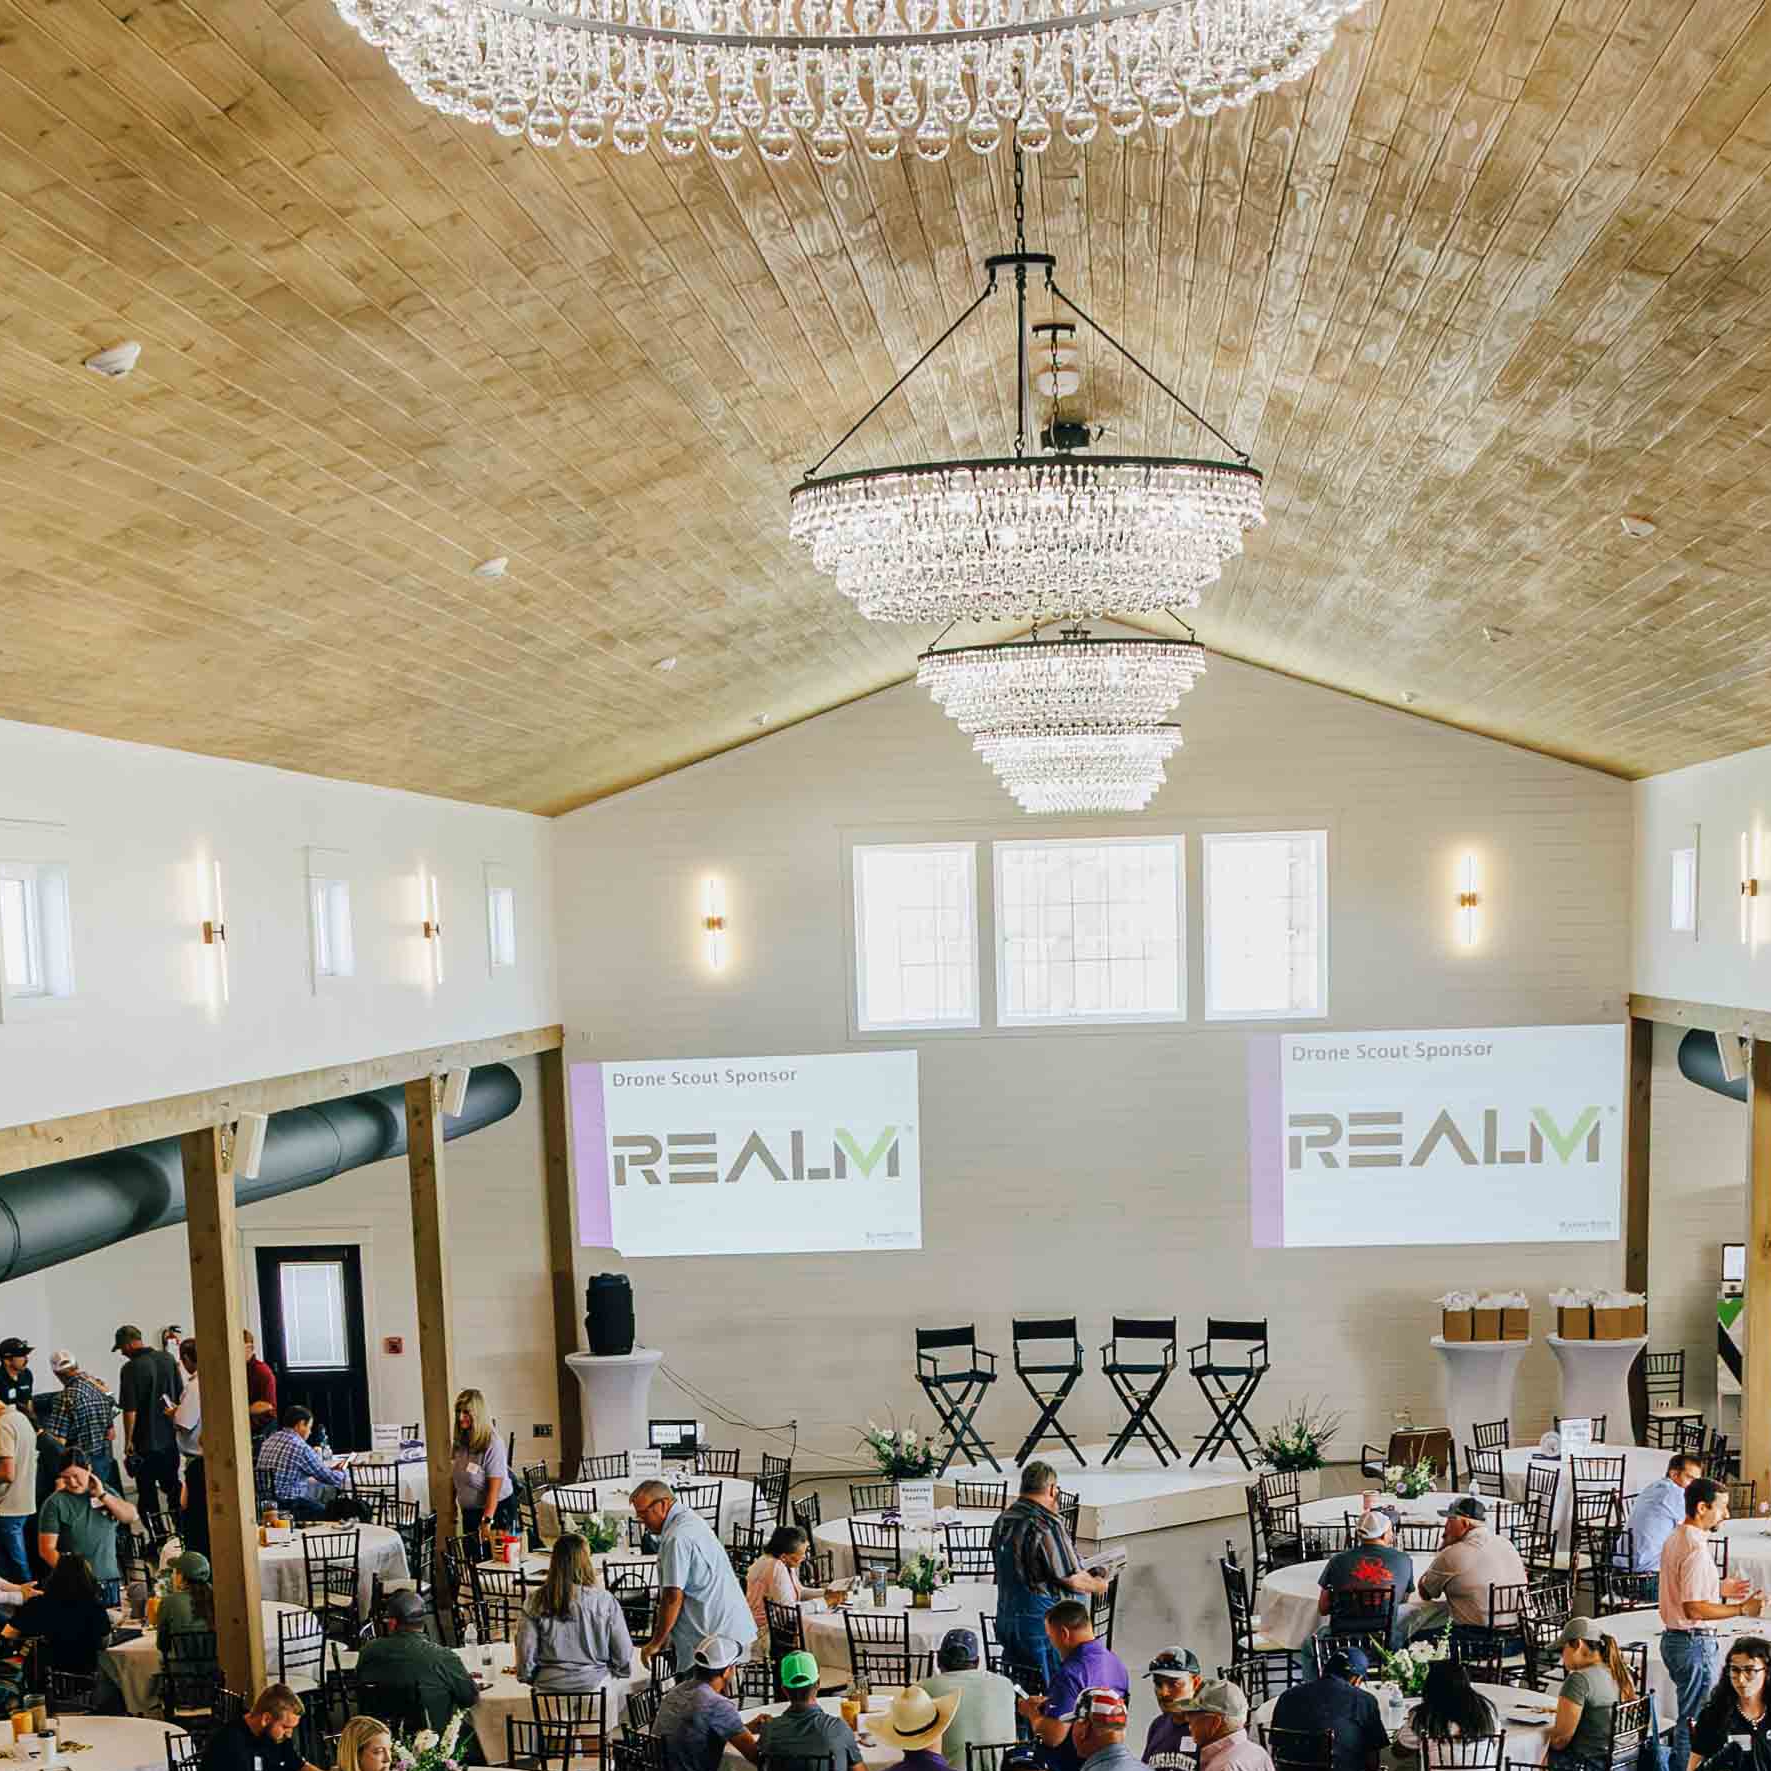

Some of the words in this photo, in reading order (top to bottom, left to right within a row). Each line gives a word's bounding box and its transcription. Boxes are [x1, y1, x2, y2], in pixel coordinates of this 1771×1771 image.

[1292, 1045, 1350, 1063] Drone
[1356, 1044, 1409, 1060] Scout
[1415, 1041, 1493, 1062] Sponsor
[613, 1072, 666, 1087] Drone
[672, 1070, 720, 1086] Scout
[725, 1068, 798, 1087] Sponsor
[612, 1125, 900, 1186] REALM
[1288, 1106, 1601, 1169] REALM
